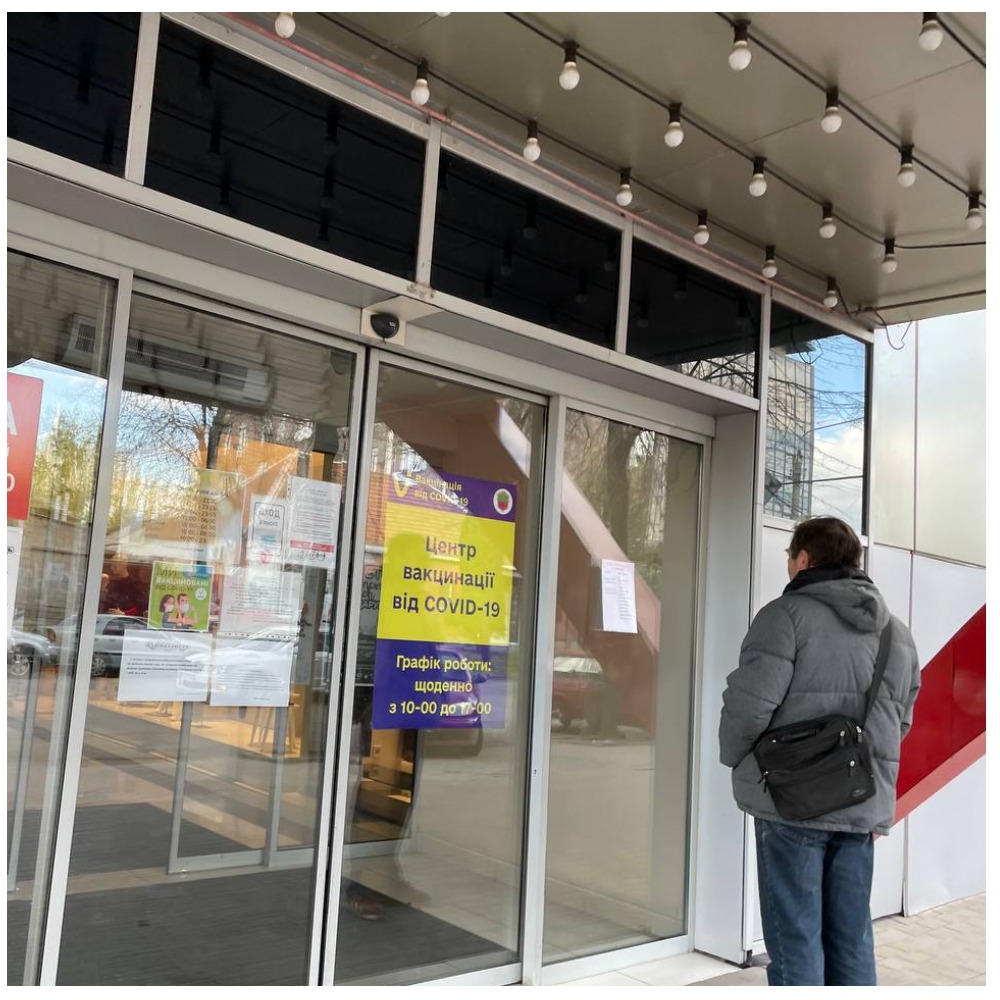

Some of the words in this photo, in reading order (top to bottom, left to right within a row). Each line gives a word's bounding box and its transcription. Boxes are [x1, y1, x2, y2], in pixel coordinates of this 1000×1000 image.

[414, 489, 428, 501] від
[430, 491, 469, 507] COV19
[426, 535, 476, 558] Центр
[155, 577, 209, 587] ВАКЦИНОВАНІ
[403, 565, 495, 589] вакцинації
[393, 594, 419, 613] від
[425, 595, 500, 618] COVID-19
[396, 655, 440, 673] Графік
[444, 657, 492, 672] роботи:
[414, 680, 473, 693] щоденно
[401, 701, 437, 715] 10-00
[440, 703, 456, 717] до
[460, 702, 492, 715] 17-00
